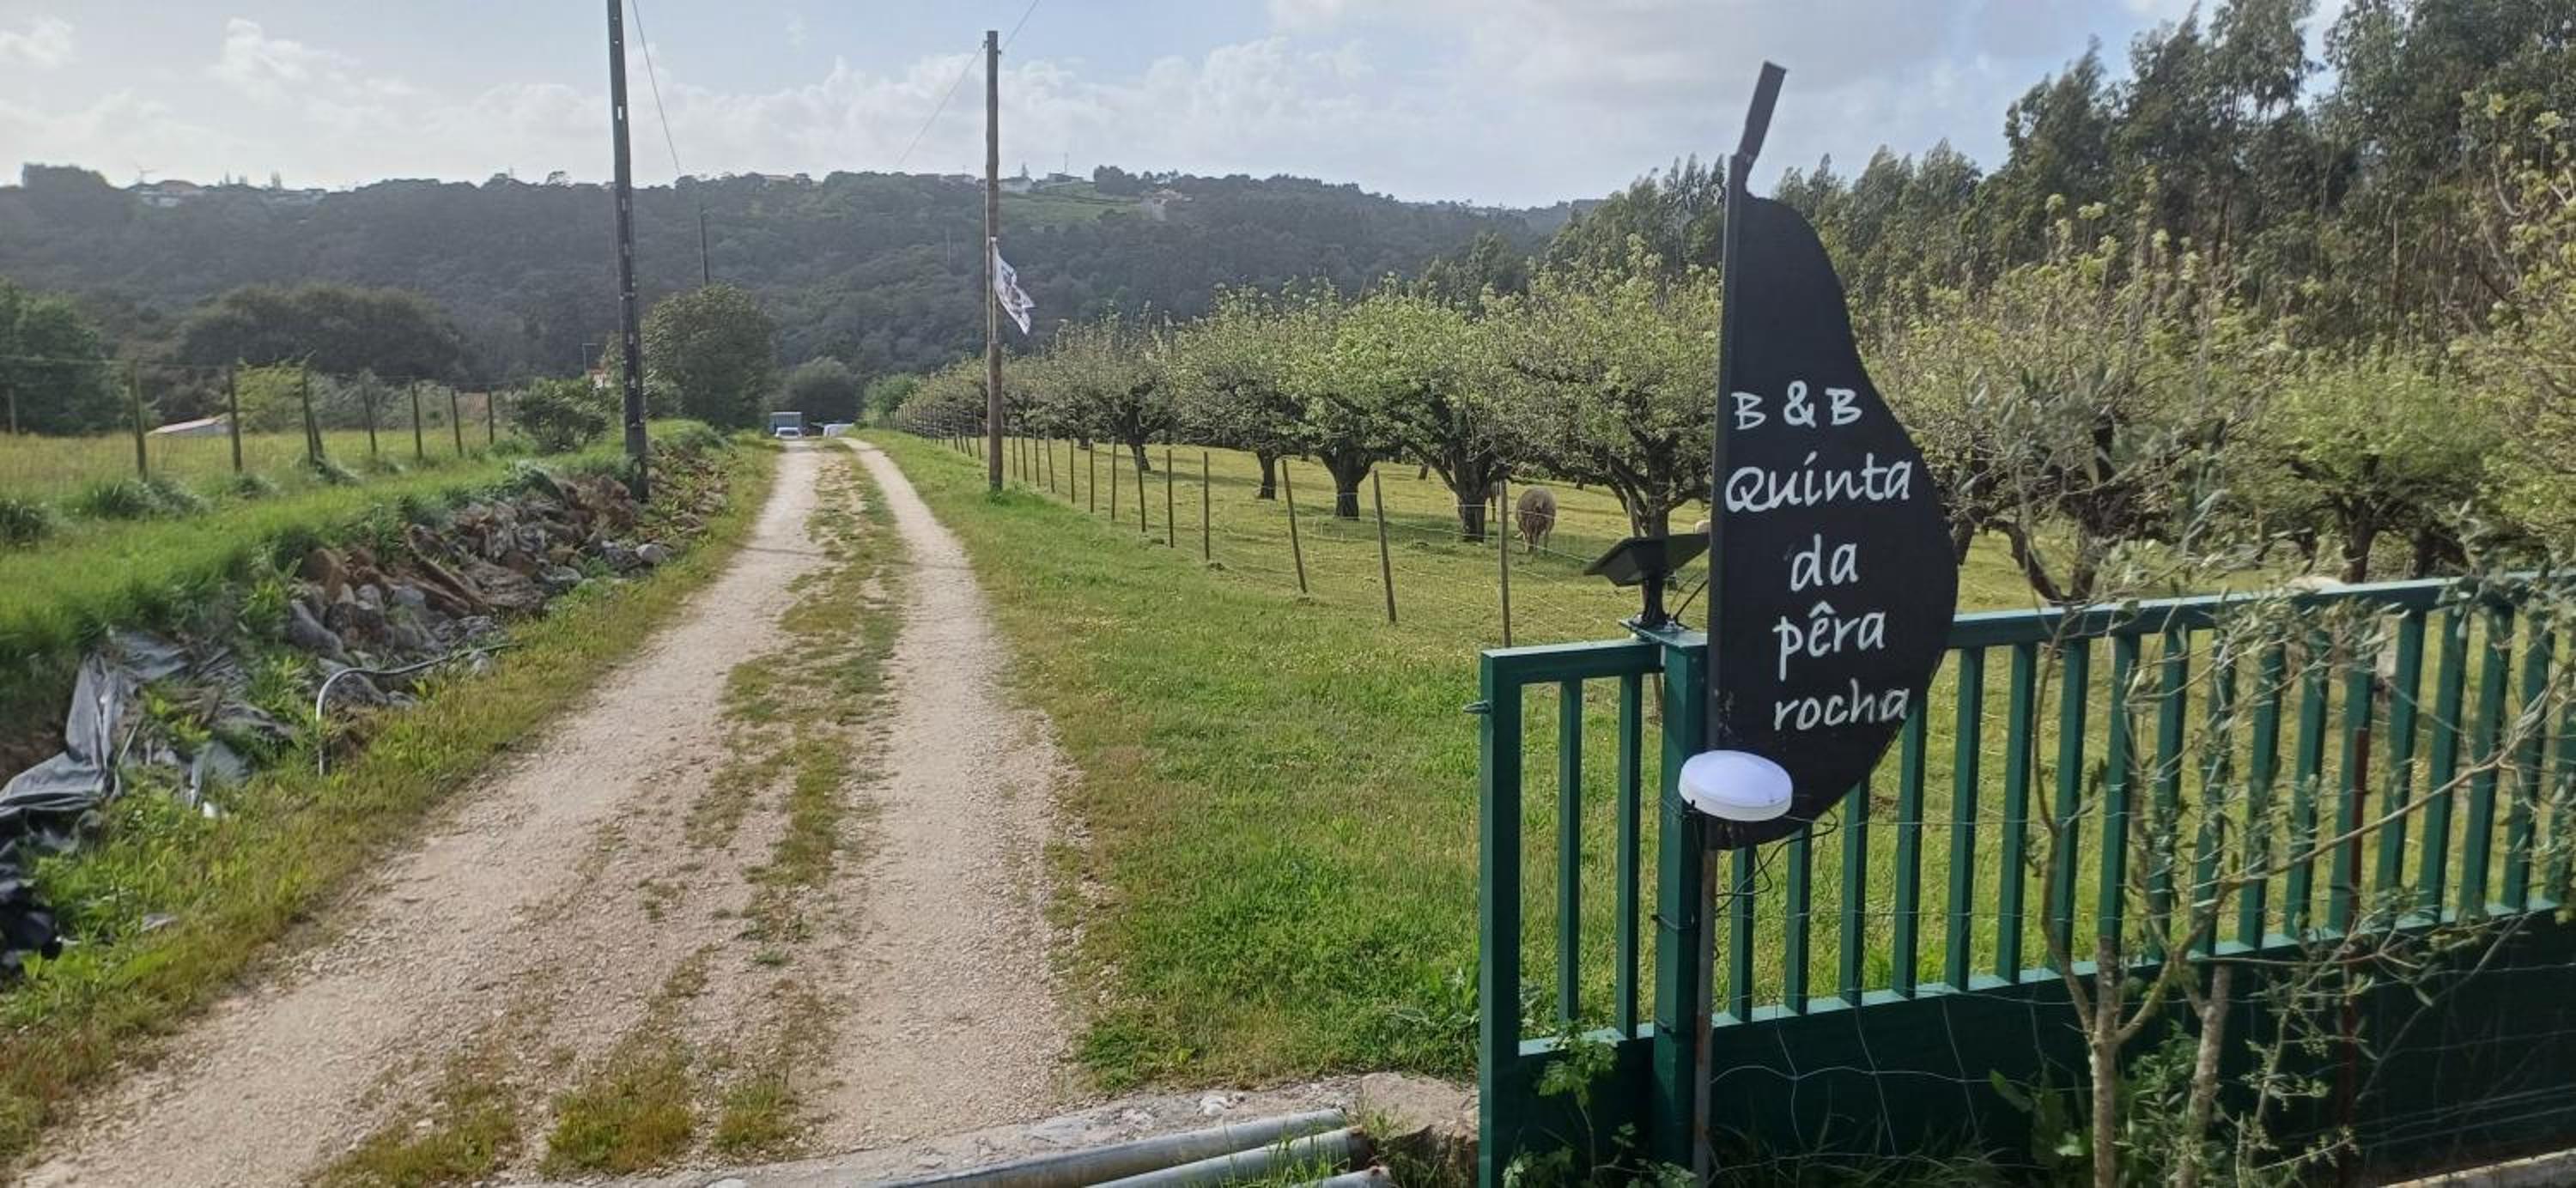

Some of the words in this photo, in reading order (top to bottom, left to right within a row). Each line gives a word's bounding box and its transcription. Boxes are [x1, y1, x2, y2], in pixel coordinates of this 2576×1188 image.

[1790, 533, 1859, 592] da
[1772, 601, 1886, 682] pêra
[1774, 678, 1911, 731] rocha
